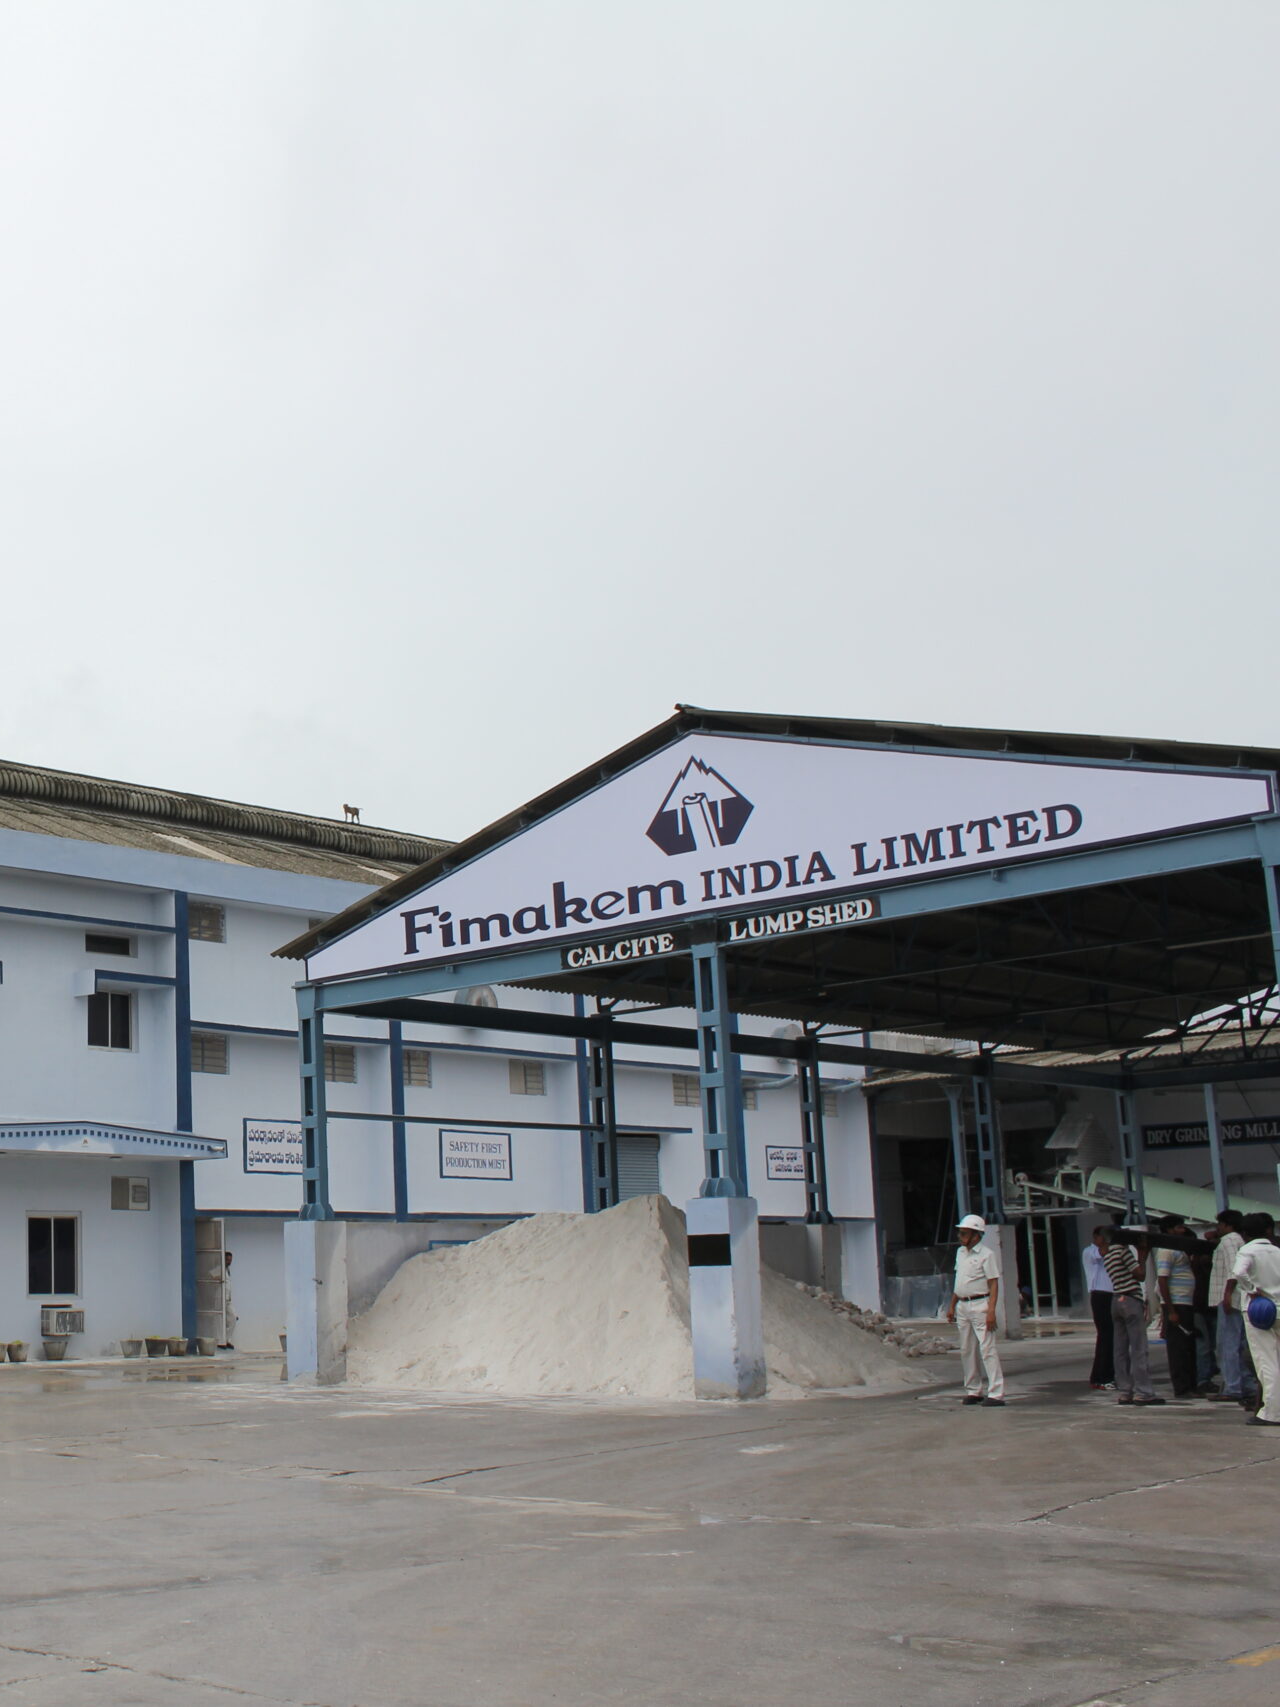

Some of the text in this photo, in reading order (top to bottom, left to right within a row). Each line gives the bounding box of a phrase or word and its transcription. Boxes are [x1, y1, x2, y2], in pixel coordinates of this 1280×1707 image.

[400, 803, 1083, 955] Fimakem INDIA LIMITED
[567, 897, 874, 970] CALCITE LUMP SHED
[1147, 1130, 1171, 1145] DRY
[1175, 1125, 1241, 1143] GRINNG
[449, 1141, 503, 1154] SAFETY FIRST
[445, 1157, 487, 1169] PRODUCTION
